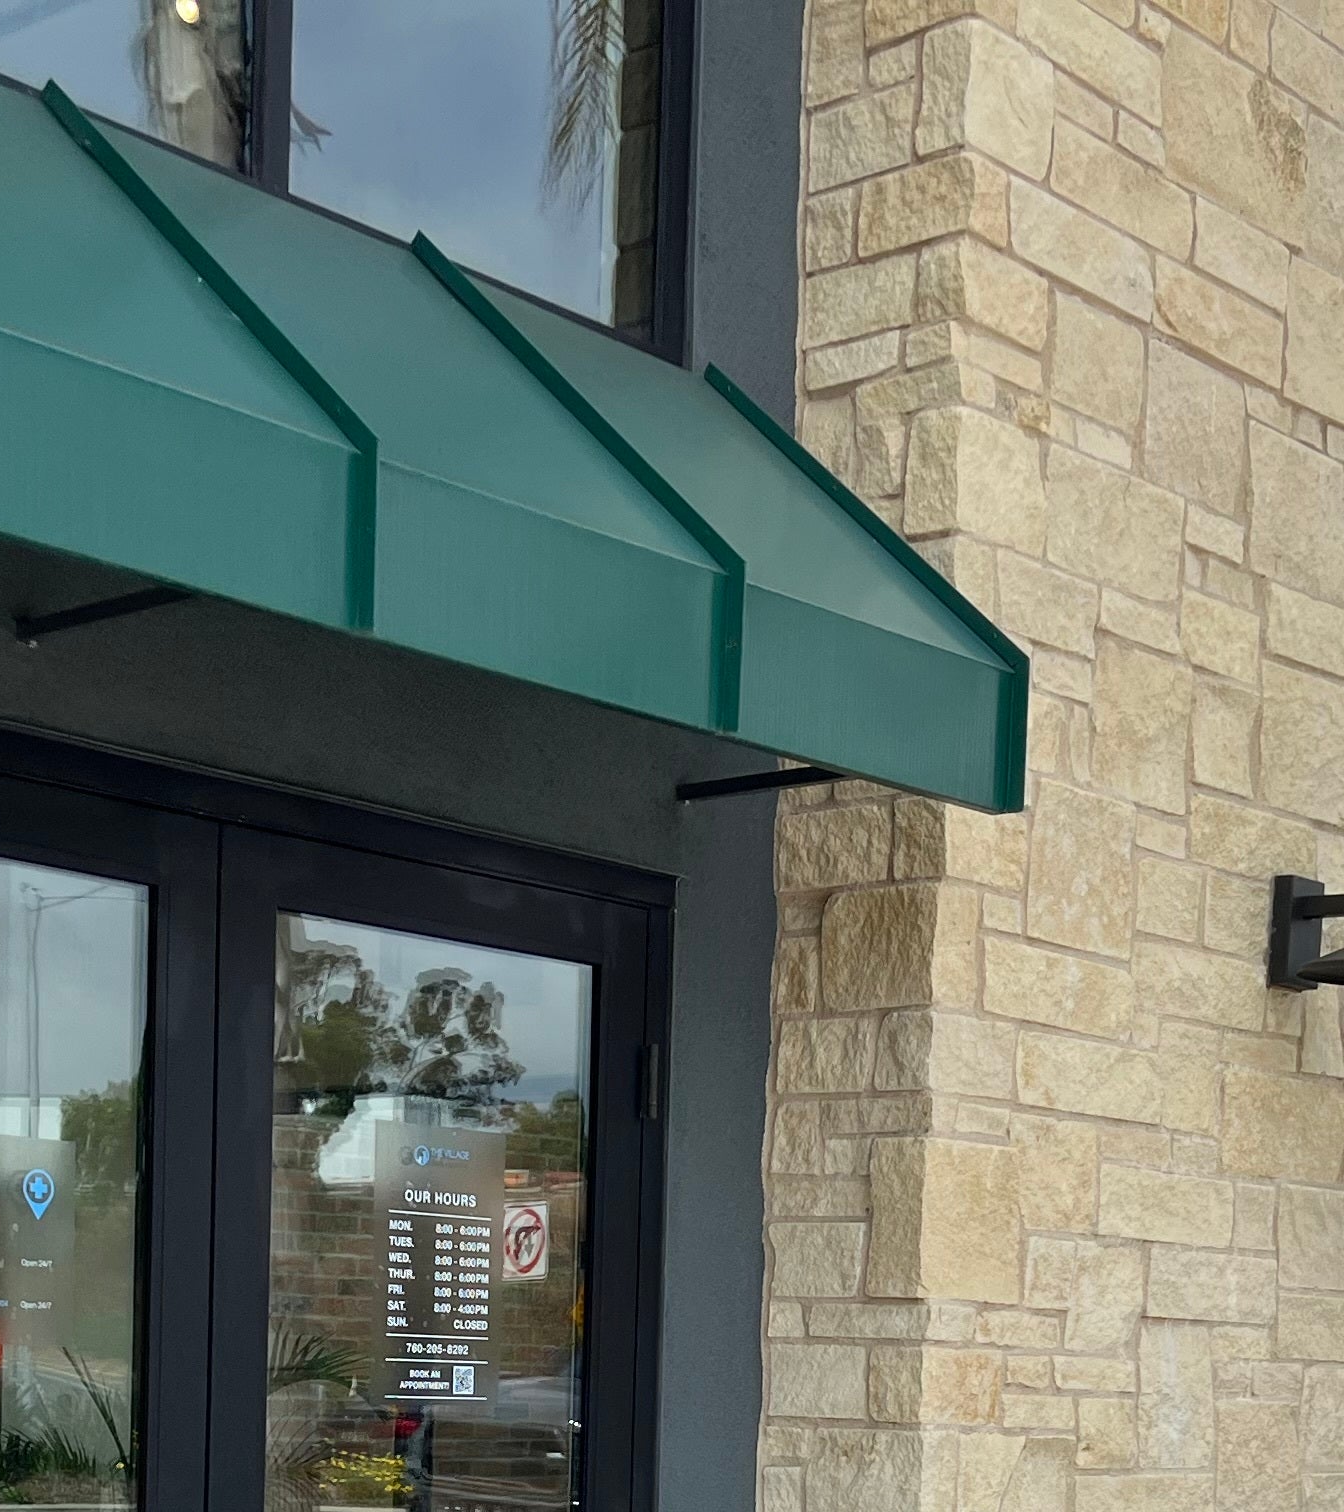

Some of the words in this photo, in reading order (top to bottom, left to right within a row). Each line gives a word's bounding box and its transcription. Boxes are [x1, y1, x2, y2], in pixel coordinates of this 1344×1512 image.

[404, 1189, 431, 1204] OUR
[434, 1191, 477, 1208] HOURS
[388, 1219, 414, 1231] MON.
[388, 1235, 415, 1248] TUES.
[388, 1252, 412, 1264] WED.
[388, 1267, 416, 1280] THUR.
[387, 1284, 405, 1295] FRI.
[387, 1300, 407, 1311] SAT.
[386, 1316, 409, 1327] SUN.
[453, 1319, 489, 1331] CLOSED
[409, 1369, 430, 1379] BOOK
